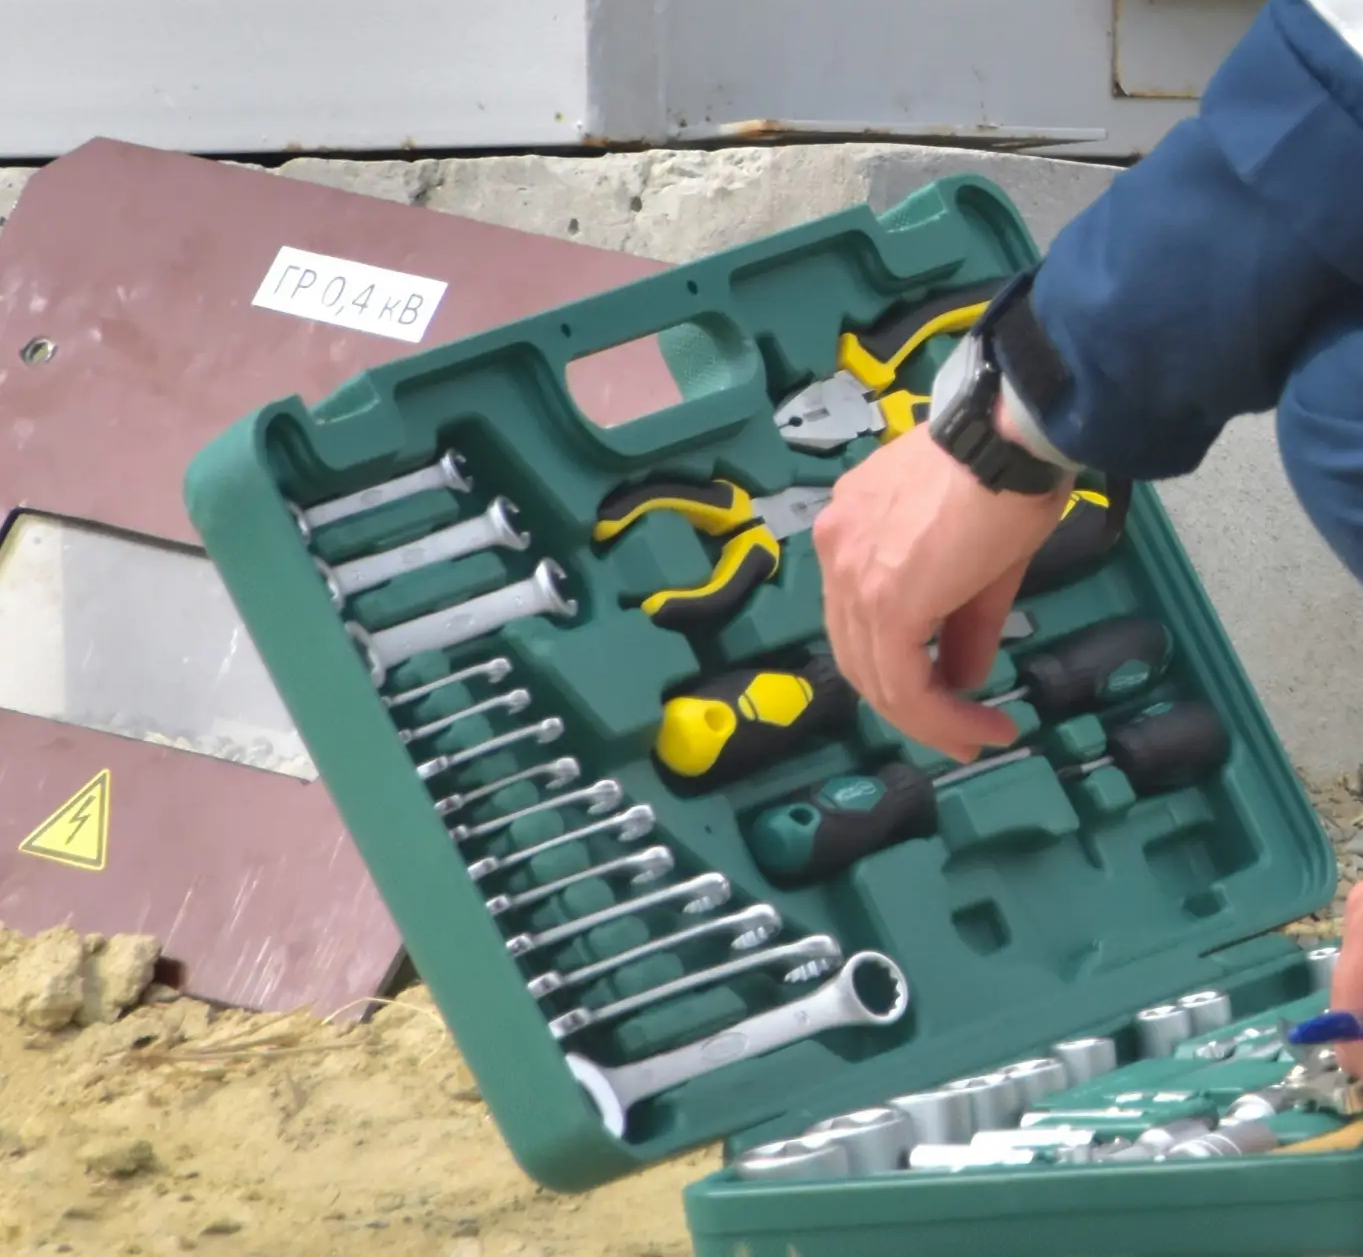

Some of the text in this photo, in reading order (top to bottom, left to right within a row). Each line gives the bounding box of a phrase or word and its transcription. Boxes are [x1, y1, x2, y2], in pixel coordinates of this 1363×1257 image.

[274, 265, 424, 325] ГР 0,4 кВ
